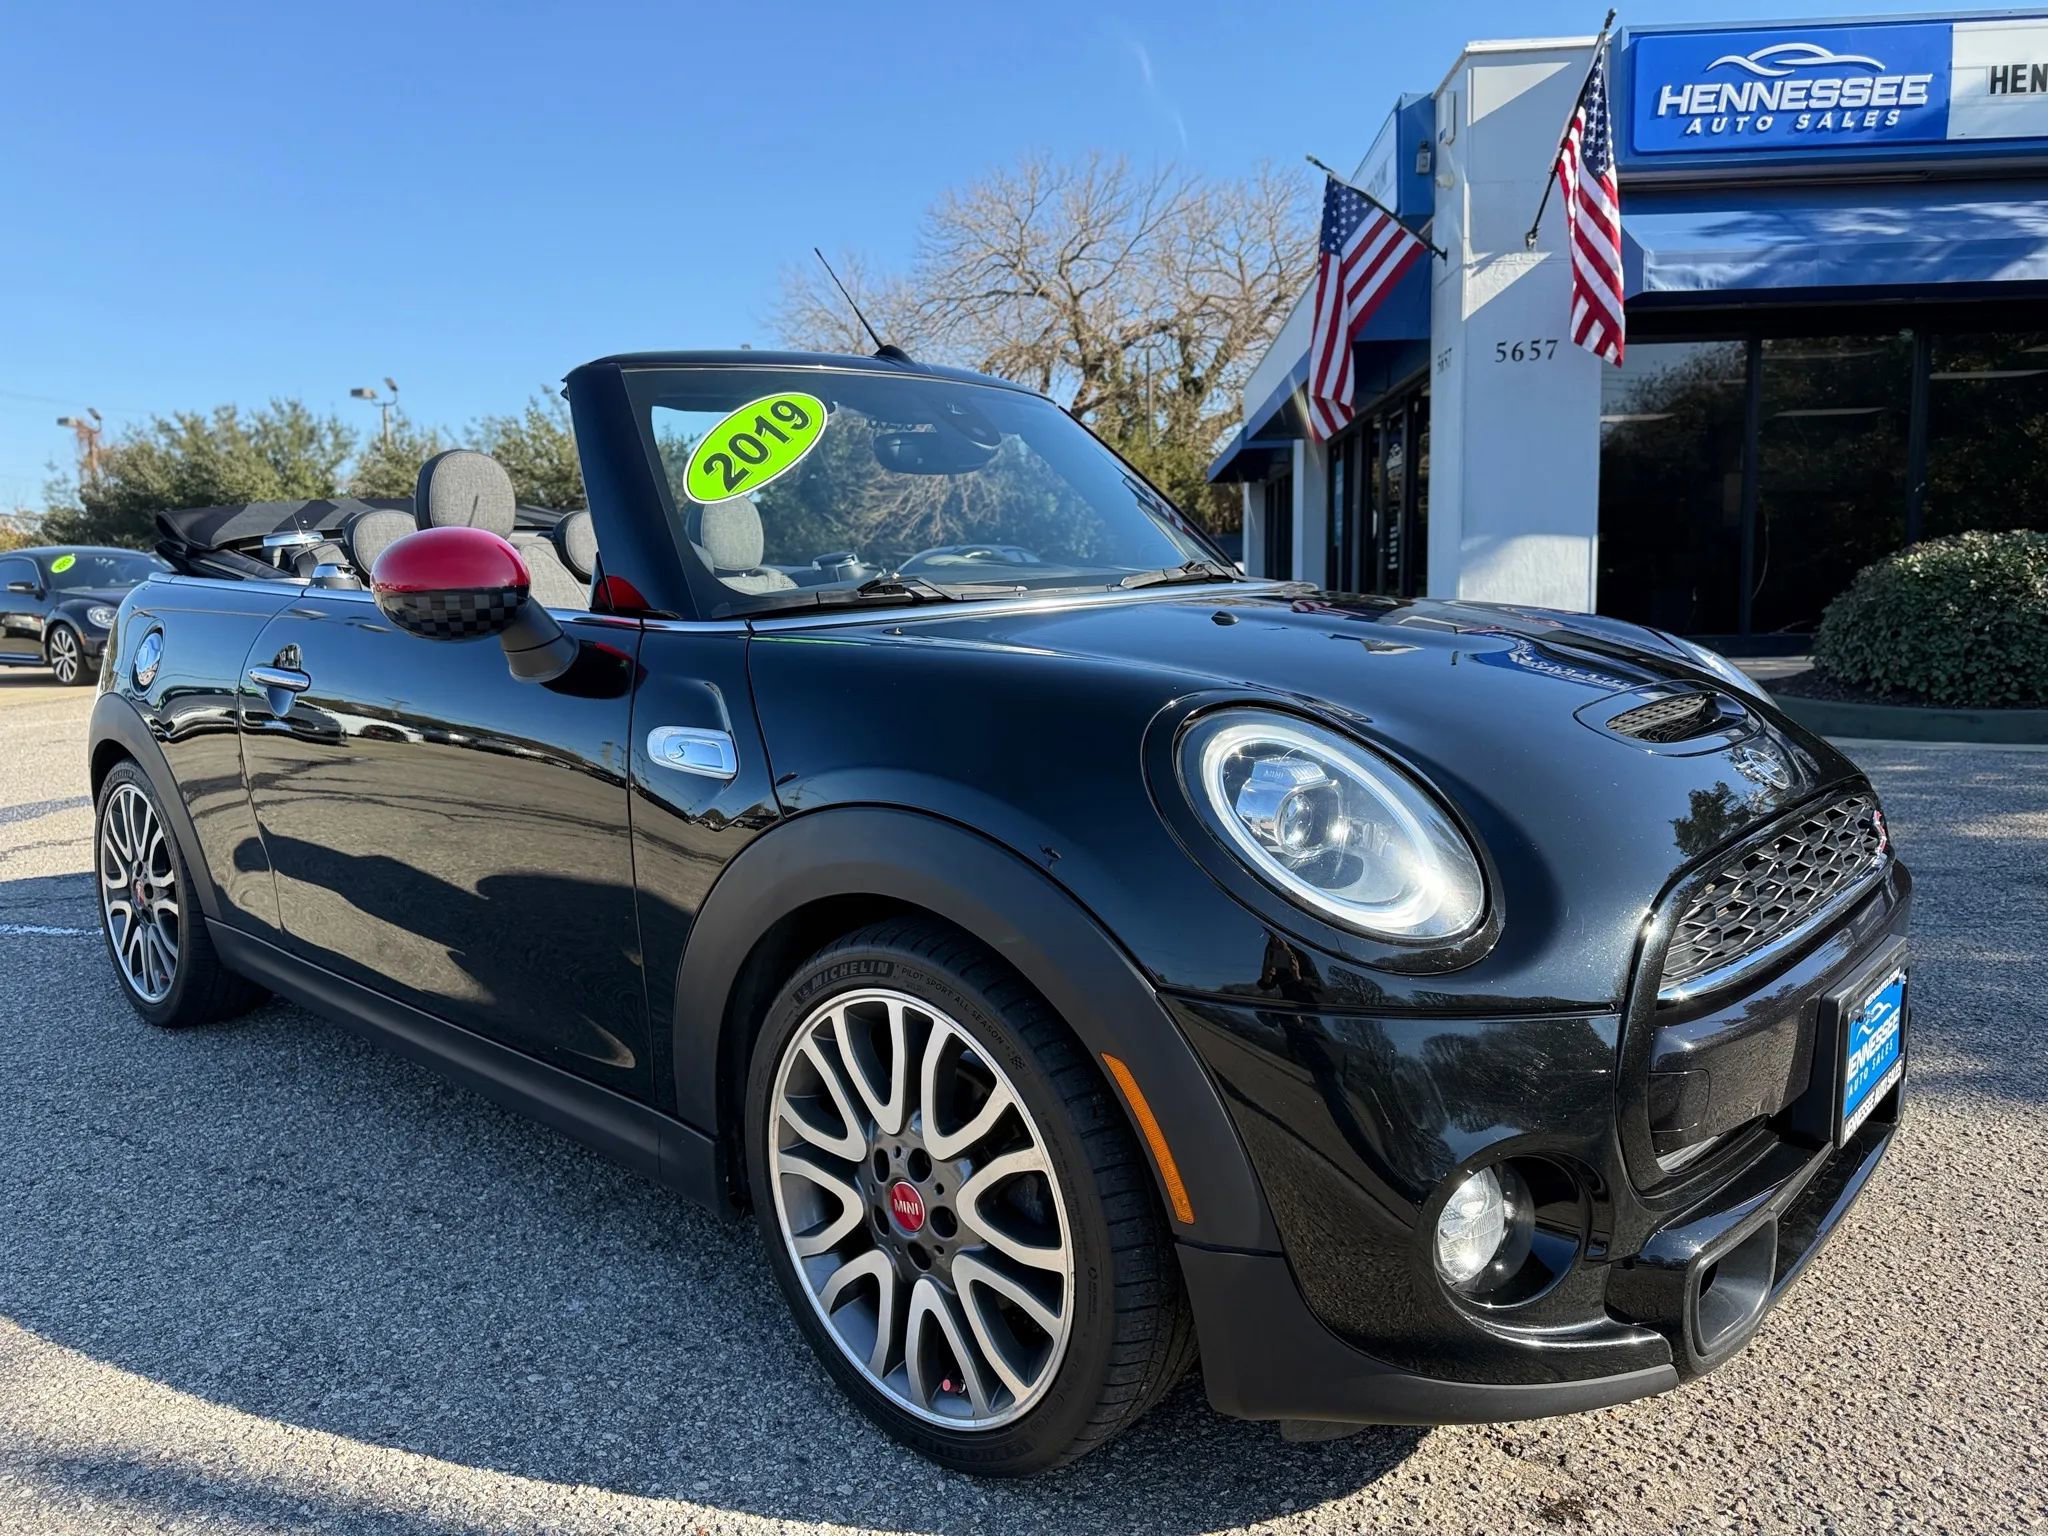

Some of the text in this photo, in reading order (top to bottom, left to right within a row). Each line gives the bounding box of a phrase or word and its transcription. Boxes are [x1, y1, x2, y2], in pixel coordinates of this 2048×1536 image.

[1657, 73, 1933, 116] HENNESSEE
[1989, 63, 2048, 95] HEN
[1685, 109, 1902, 135] AUTO SALES
[1495, 339, 1559, 363] 5657
[703, 400, 810, 493] 2019
[811, 961, 889, 990] MICHELIN
[901, 967, 924, 981] PILOT
[926, 977, 954, 997] SPORT
[954, 996, 969, 1011] ALL
[971, 1010, 1005, 1044] SEASON
[1848, 1038, 1894, 1098] AUTO SALES
[893, 1197, 920, 1216] MINI
